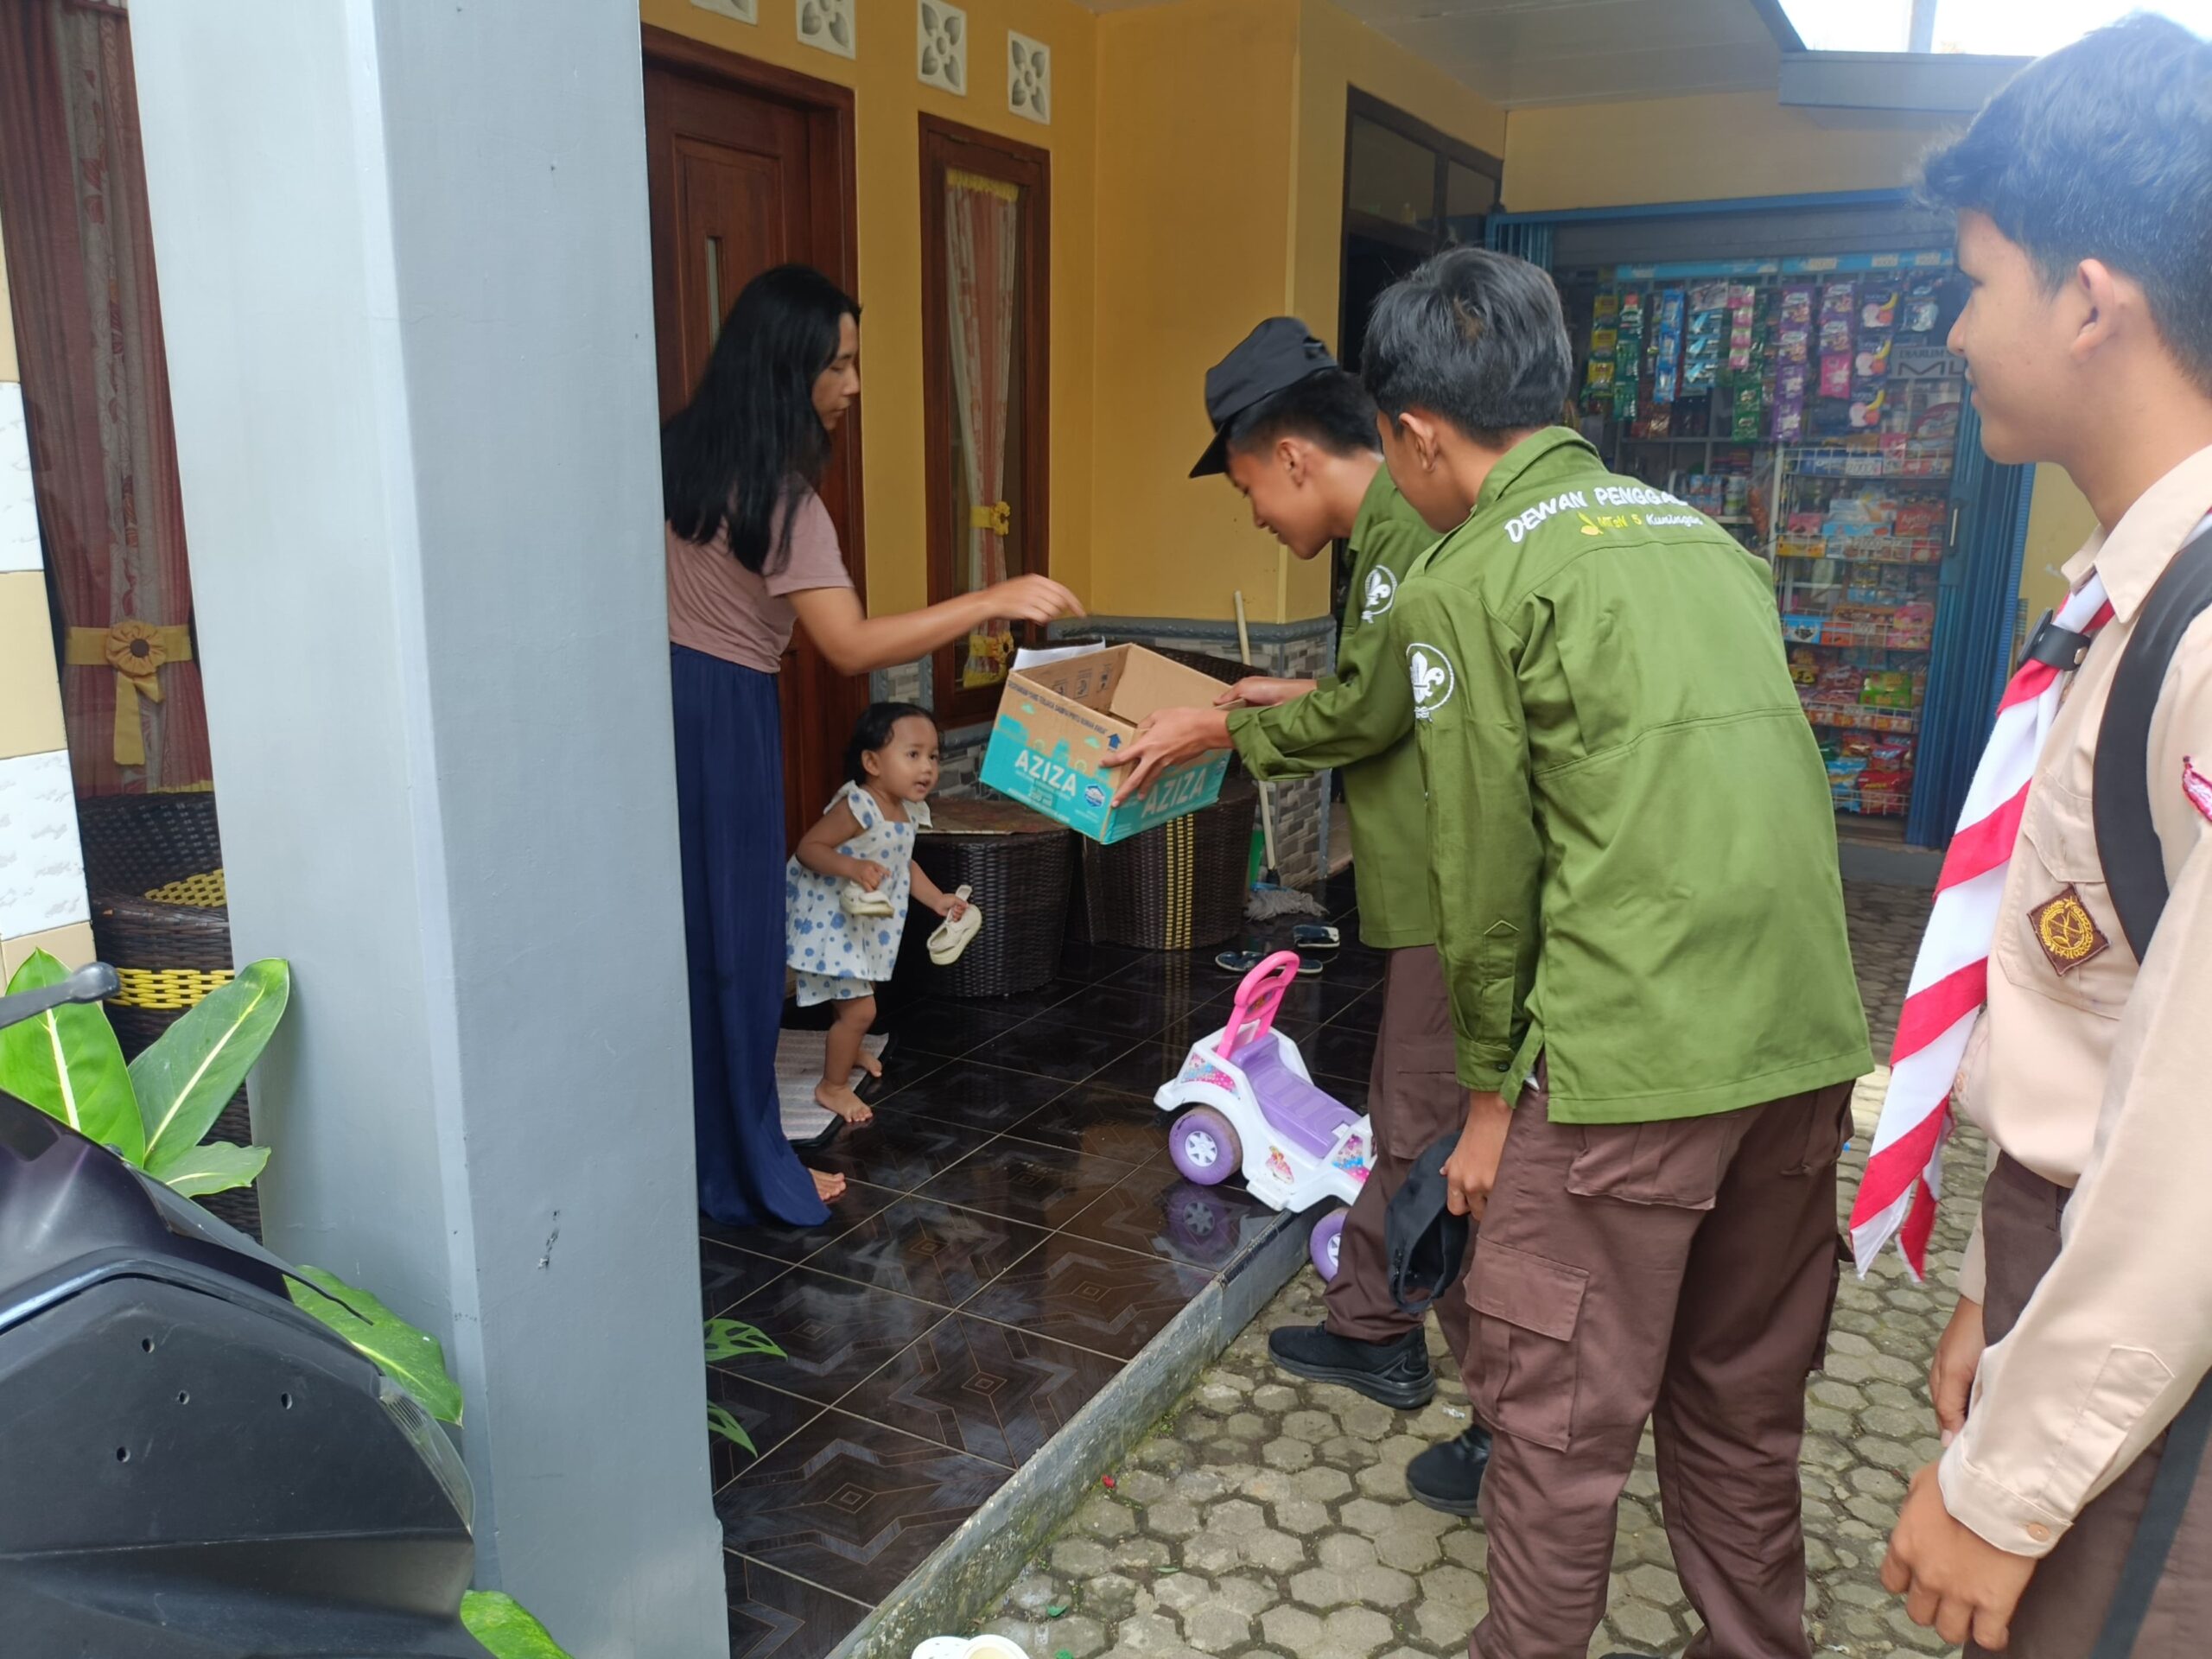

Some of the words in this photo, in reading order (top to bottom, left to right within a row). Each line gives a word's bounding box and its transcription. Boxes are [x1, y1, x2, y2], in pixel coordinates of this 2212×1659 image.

[1504, 490, 1588, 543] DEWAN
[1631, 513, 1642, 525] 5
[1646, 513, 1704, 527] Kuningan
[1015, 749, 1077, 797] AZIZA
[1141, 767, 1207, 818] AZIZA
